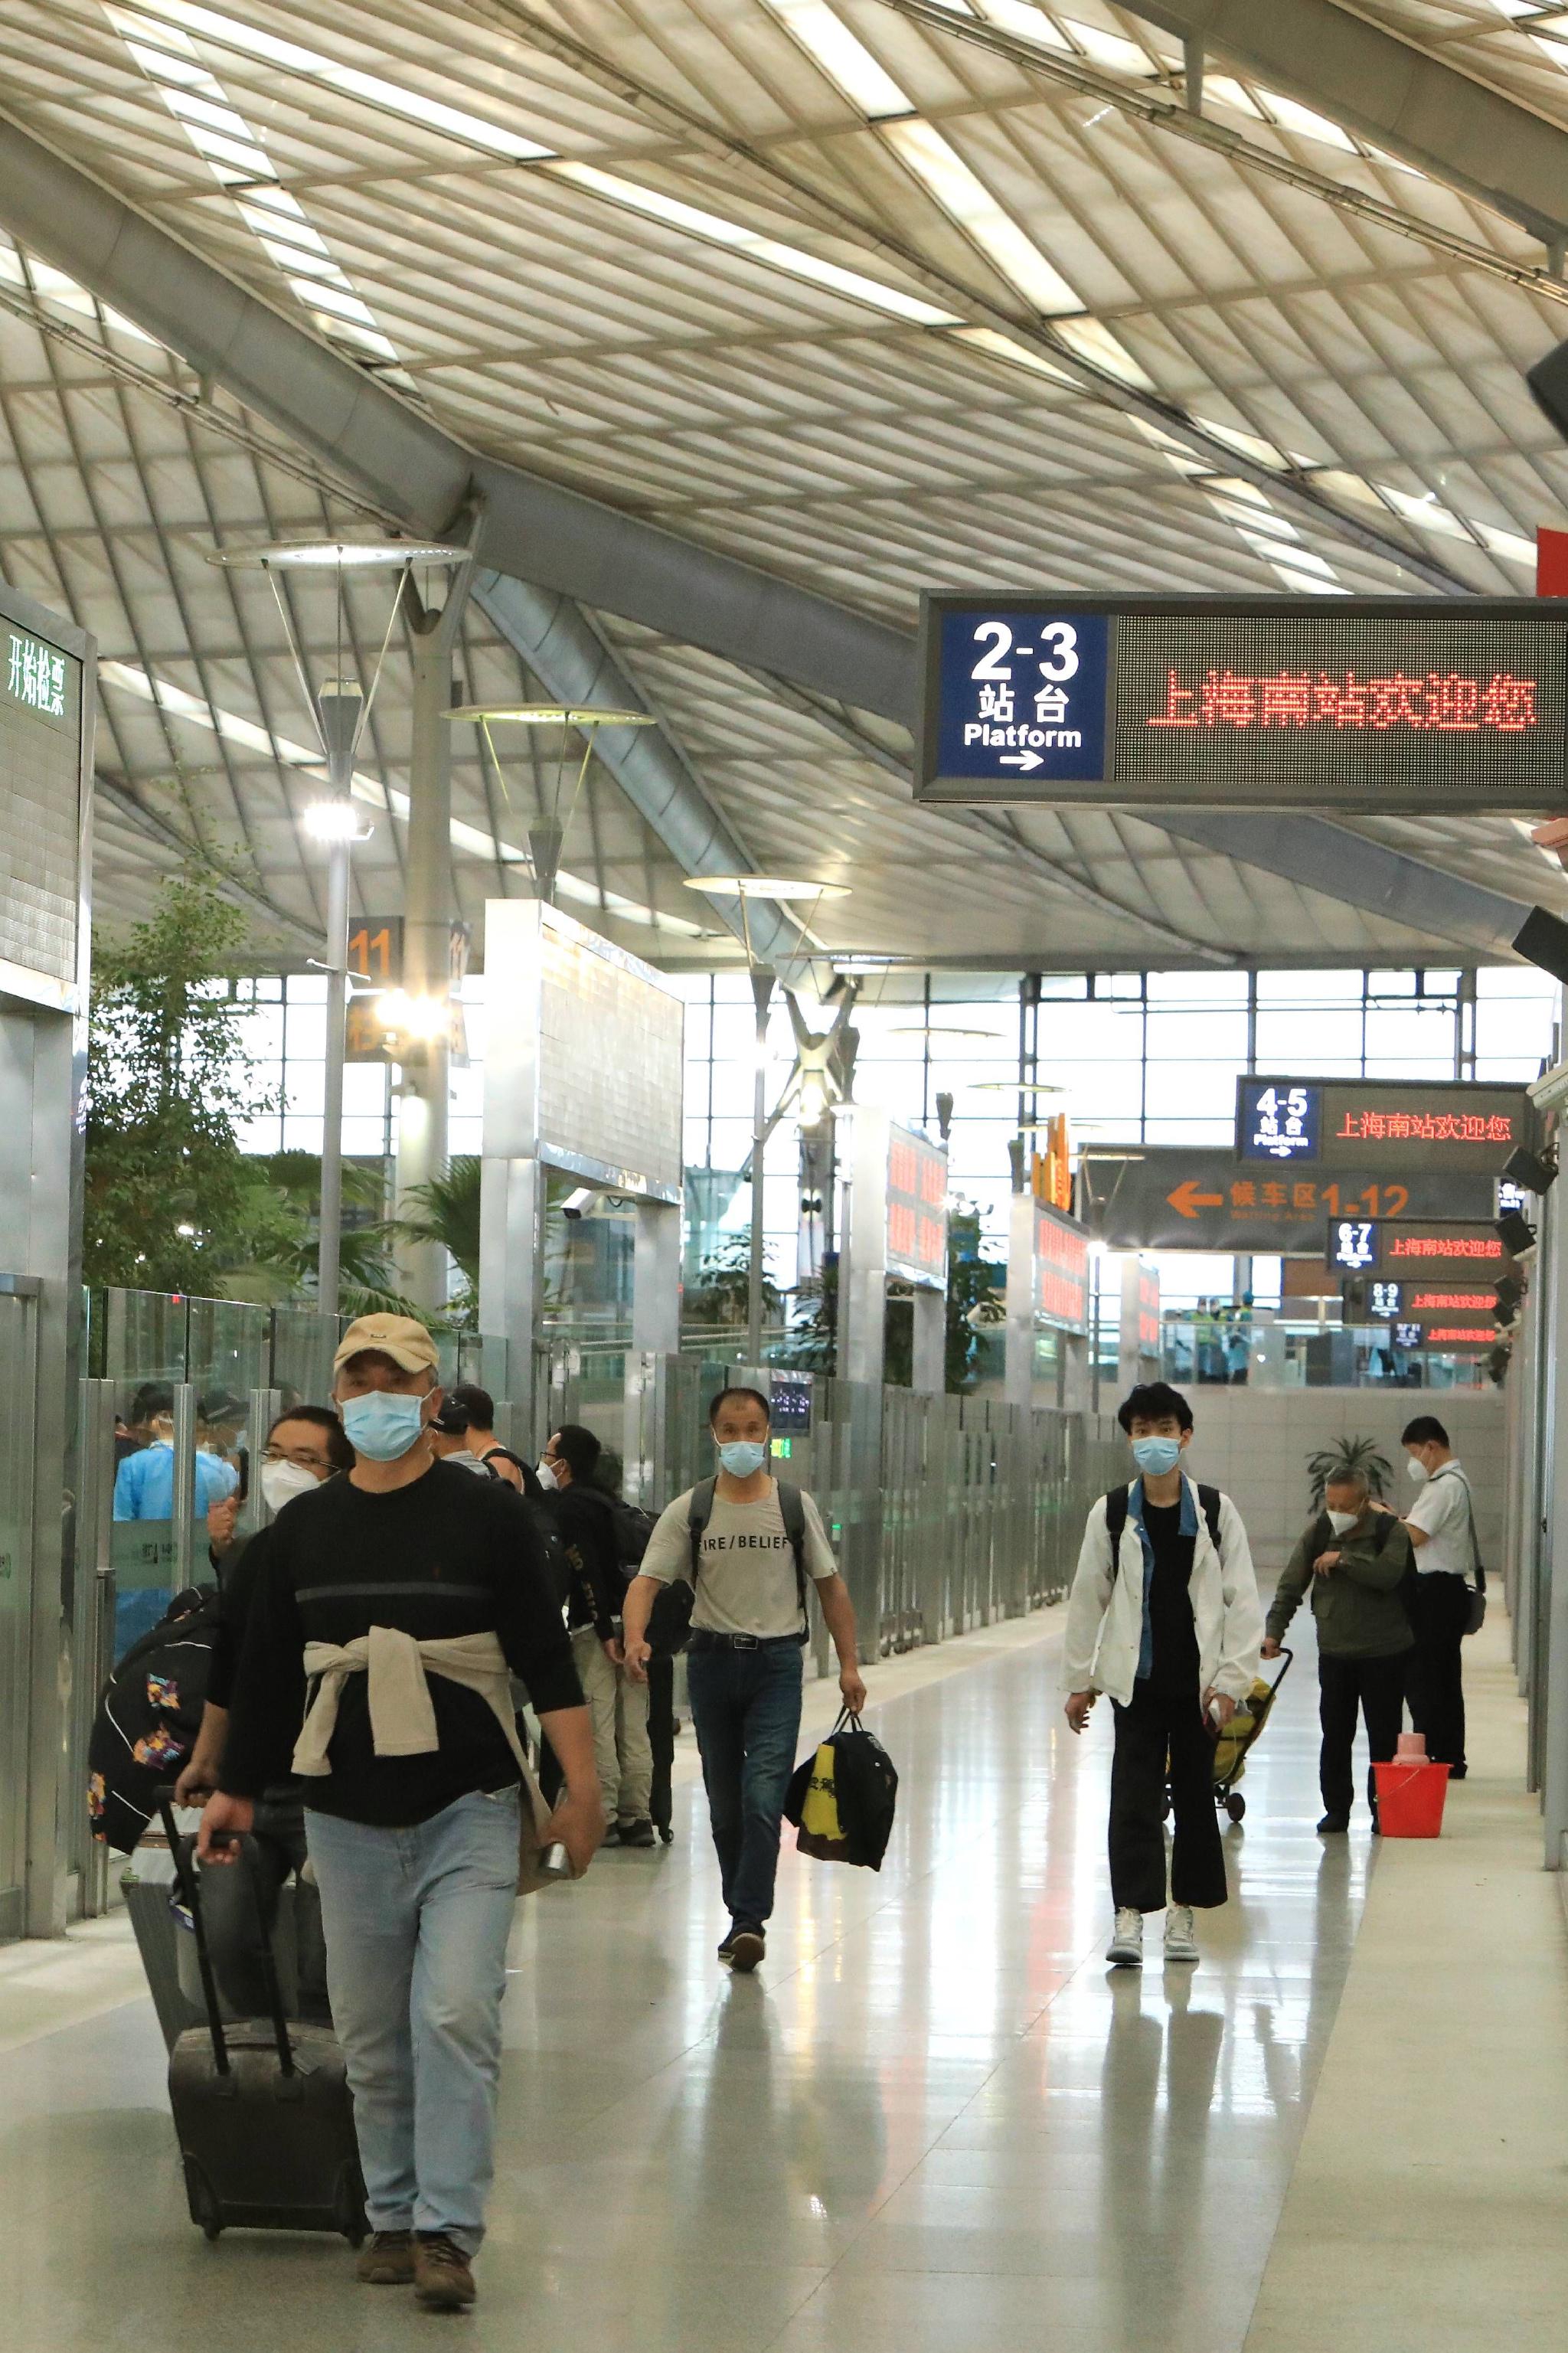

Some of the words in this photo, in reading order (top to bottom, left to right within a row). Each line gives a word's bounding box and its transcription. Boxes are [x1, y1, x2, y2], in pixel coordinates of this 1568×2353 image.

[972, 621, 1080, 681] 2-3
[978, 683, 1070, 724] 站台
[1148, 669, 1538, 731] 上海南站欢迎您
[964, 723, 1082, 748] Platform
[1256, 1087, 1308, 1117] 4-5
[1336, 1111, 1511, 1142] 上海南站欢迎您
[1338, 1223, 1372, 1242] 6-7
[1390, 1238, 1501, 1258] 上海南站欢迎您
[1373, 1283, 1399, 1298] 8-9
[698, 1534, 789, 1552] IRE/BELIEF
